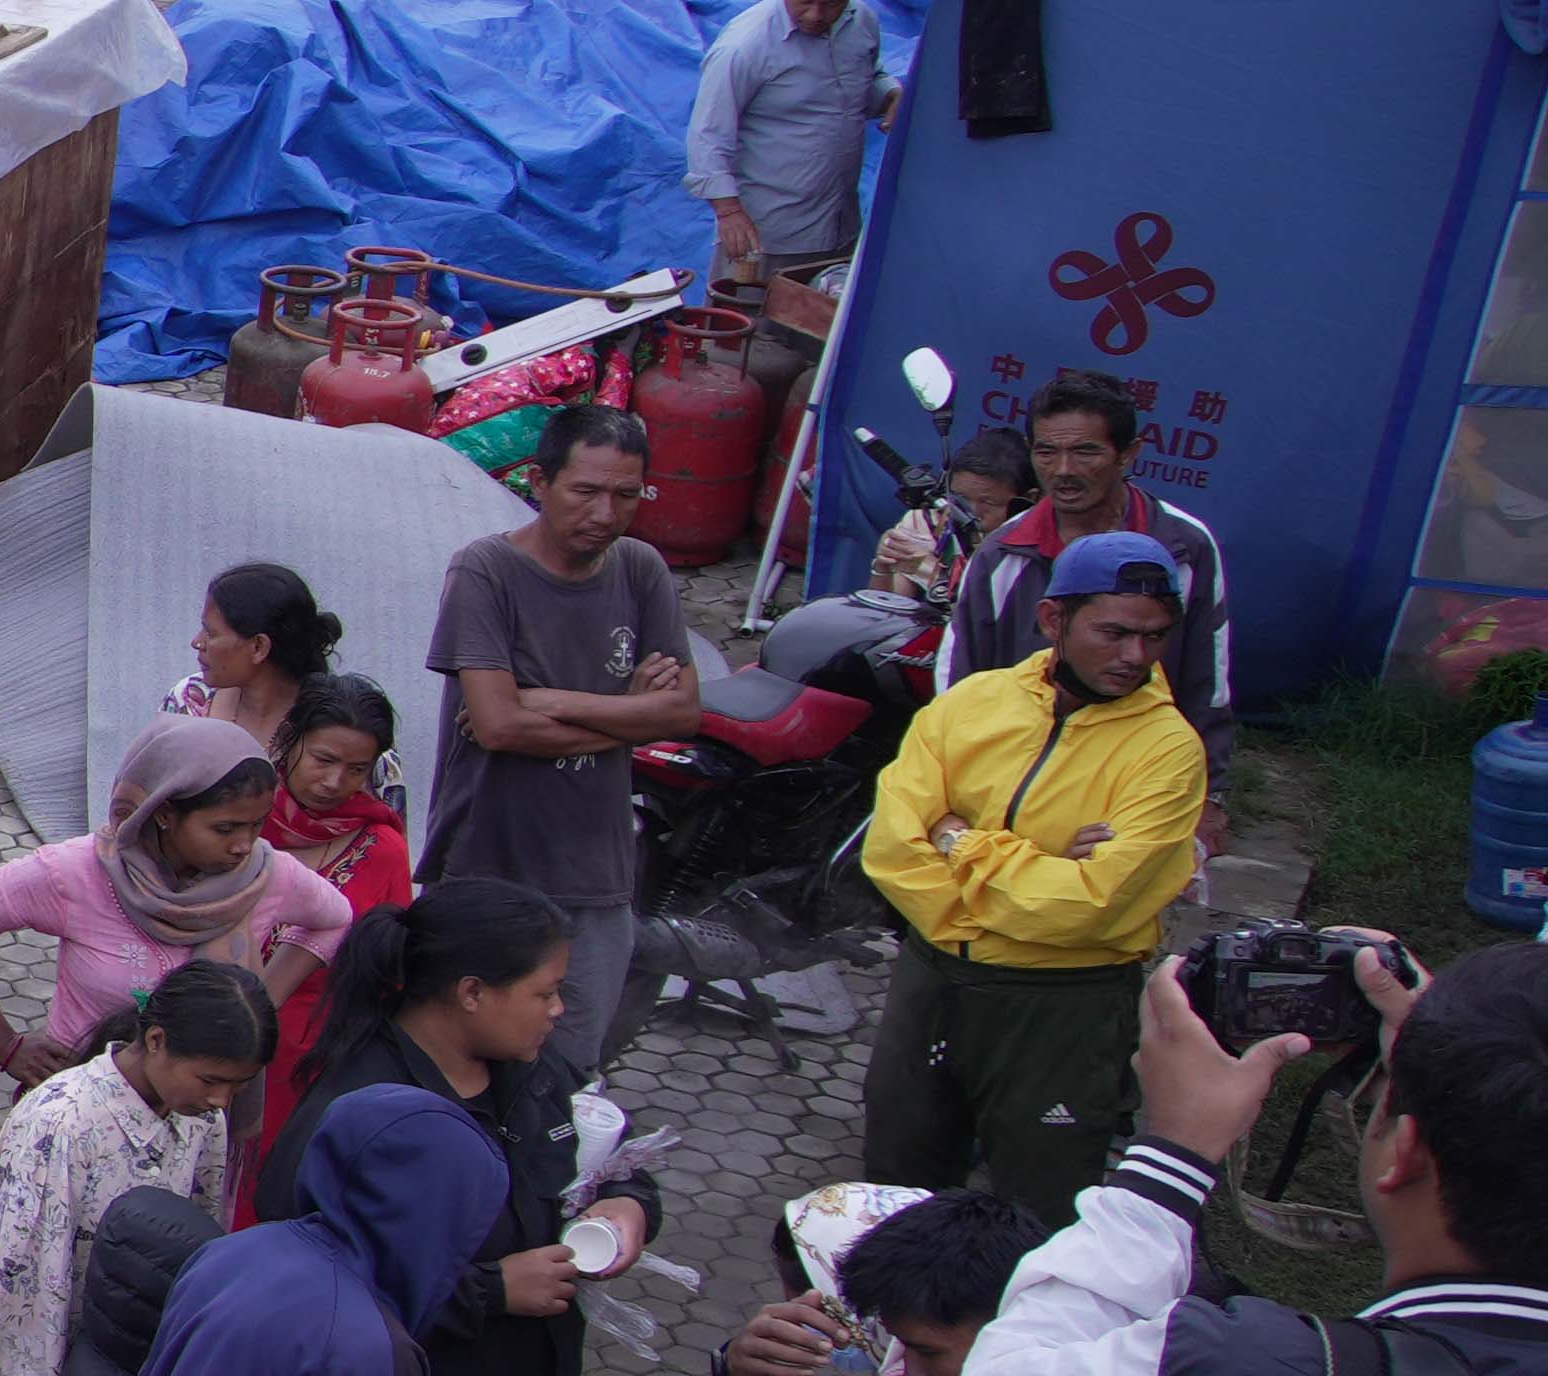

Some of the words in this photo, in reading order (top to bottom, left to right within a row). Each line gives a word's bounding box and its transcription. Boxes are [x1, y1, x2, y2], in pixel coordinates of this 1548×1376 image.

[991, 353, 1228, 424] 中援助
[1139, 422, 1219, 461] AID
[1131, 458, 1209, 489] UTURE
